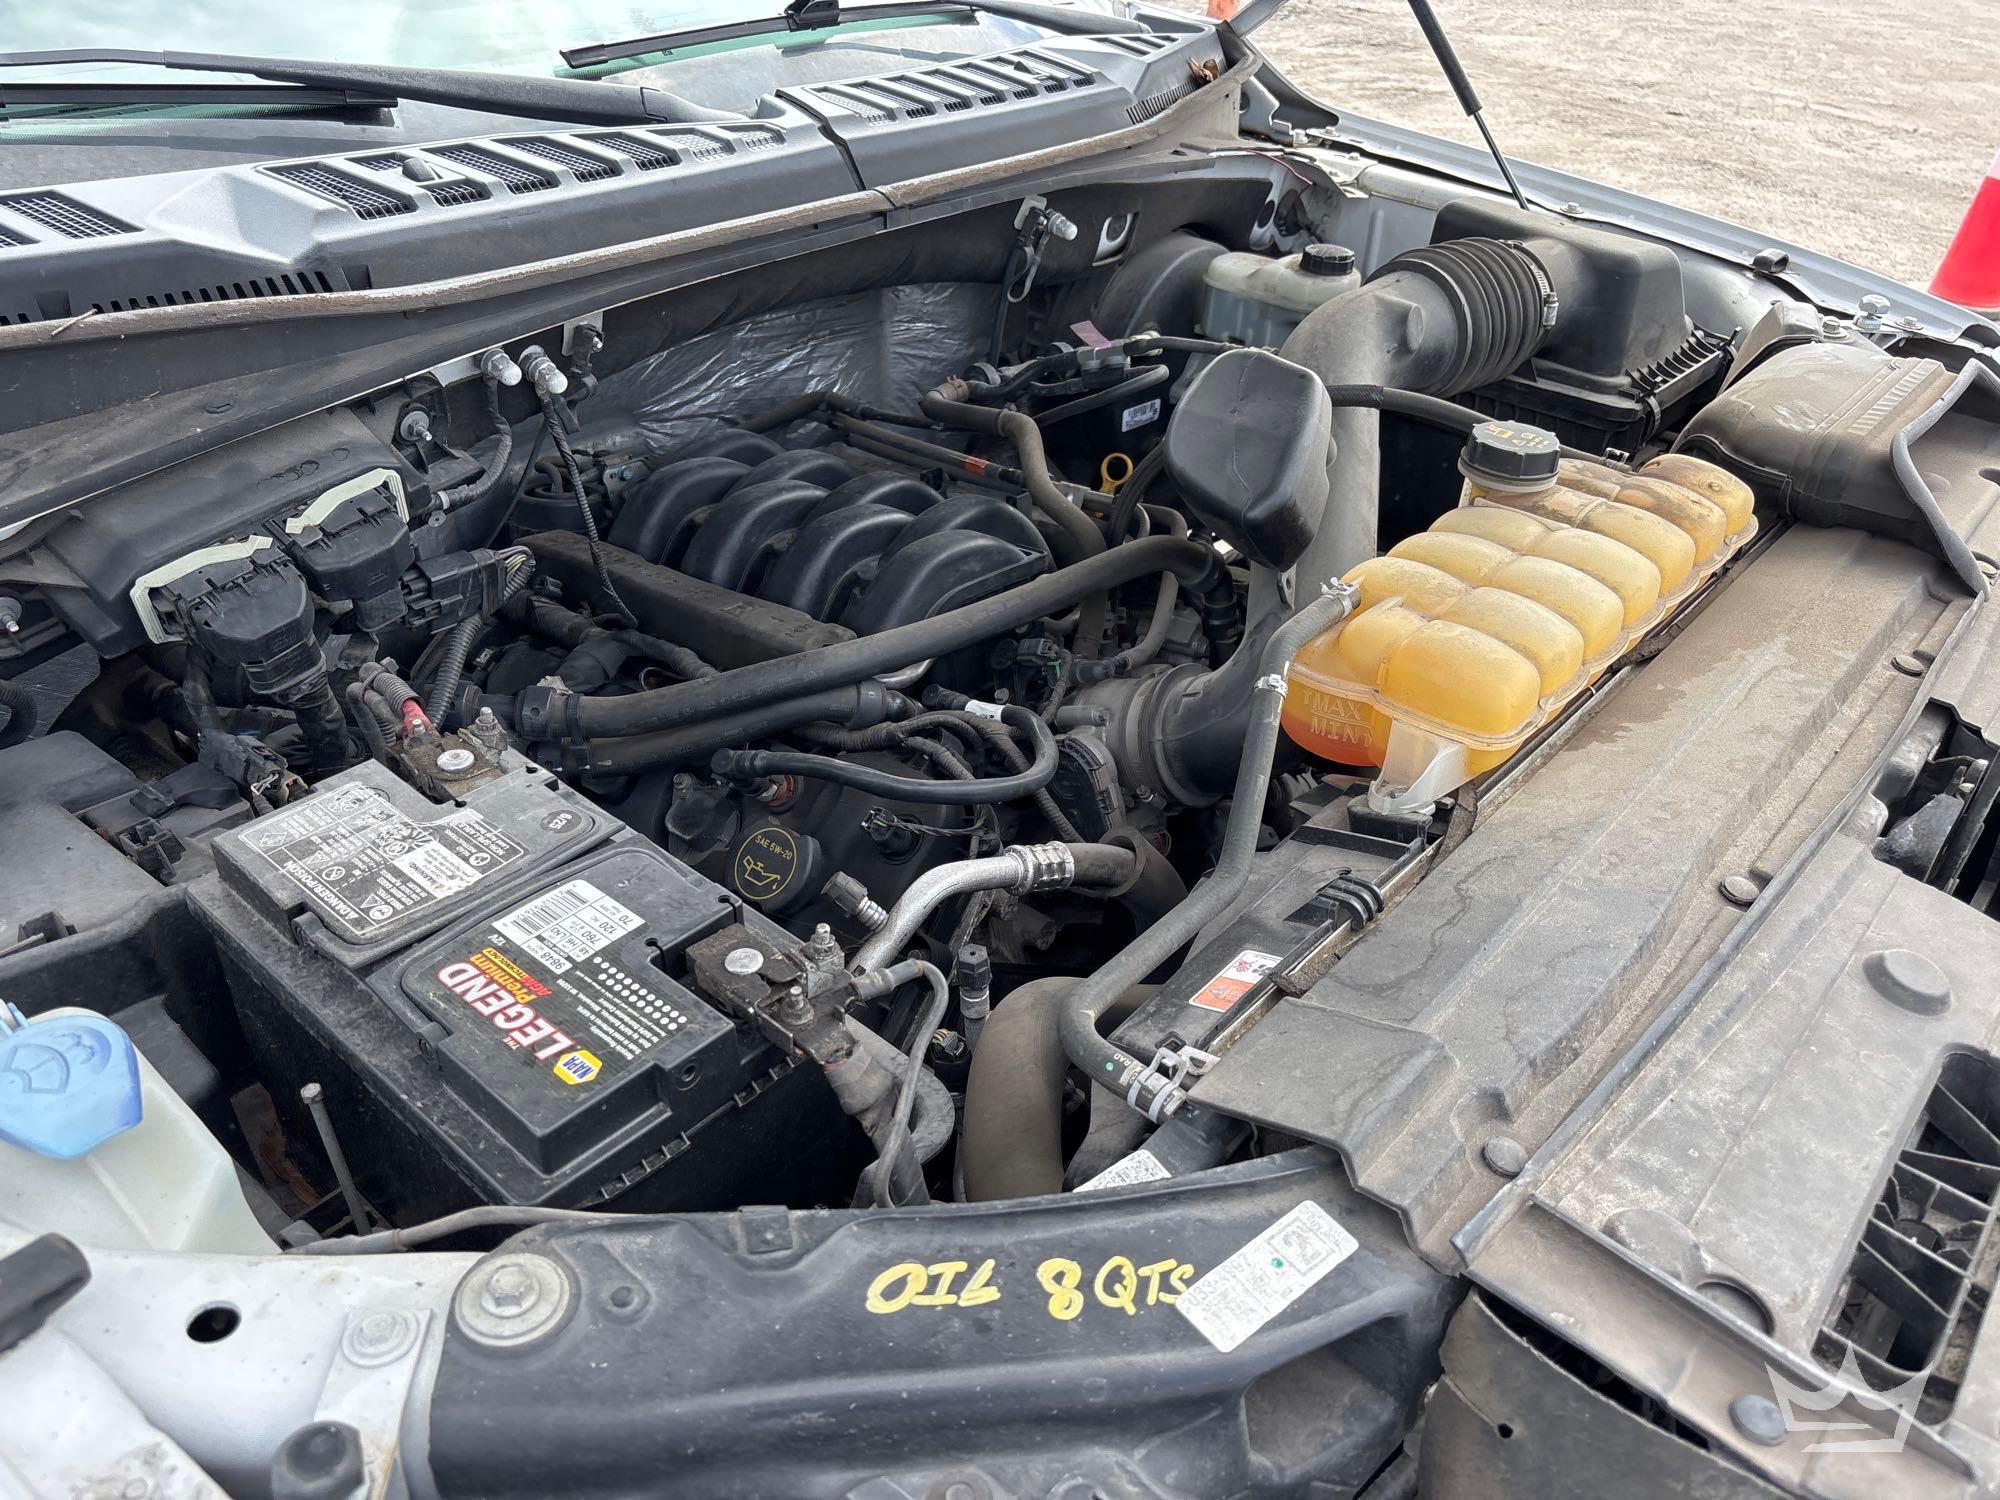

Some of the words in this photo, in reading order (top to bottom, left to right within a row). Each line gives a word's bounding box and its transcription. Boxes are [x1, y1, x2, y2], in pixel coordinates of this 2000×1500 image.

[1312, 693, 1361, 721] MAX
[1311, 716, 1361, 744] MIN
[755, 834, 771, 849] SAE
[769, 841, 793, 861] 5W-20
[282, 859, 353, 915] DANGER/POISON
[597, 920, 618, 935] 120
[617, 913, 634, 926] 70
[486, 930, 508, 947] 12V
[549, 925, 567, 939] LN3
[564, 936, 579, 947] H6
[579, 928, 602, 945] 760
[538, 950, 566, 970] 9848
[577, 946, 590, 956] 48
[482, 947, 527, 979] TECHNOLOGY
[468, 952, 537, 1004] Premium
[517, 974, 552, 996] AGM
[436, 961, 576, 1061] LEGEND
[500, 1035, 521, 1050] THE
[560, 1054, 595, 1080] NAPA
[1113, 1052, 1133, 1067] RAD
[865, 1258, 1001, 1314] OIL
[1037, 1257, 1083, 1320] 8
[1093, 1255, 1196, 1316] QTS
